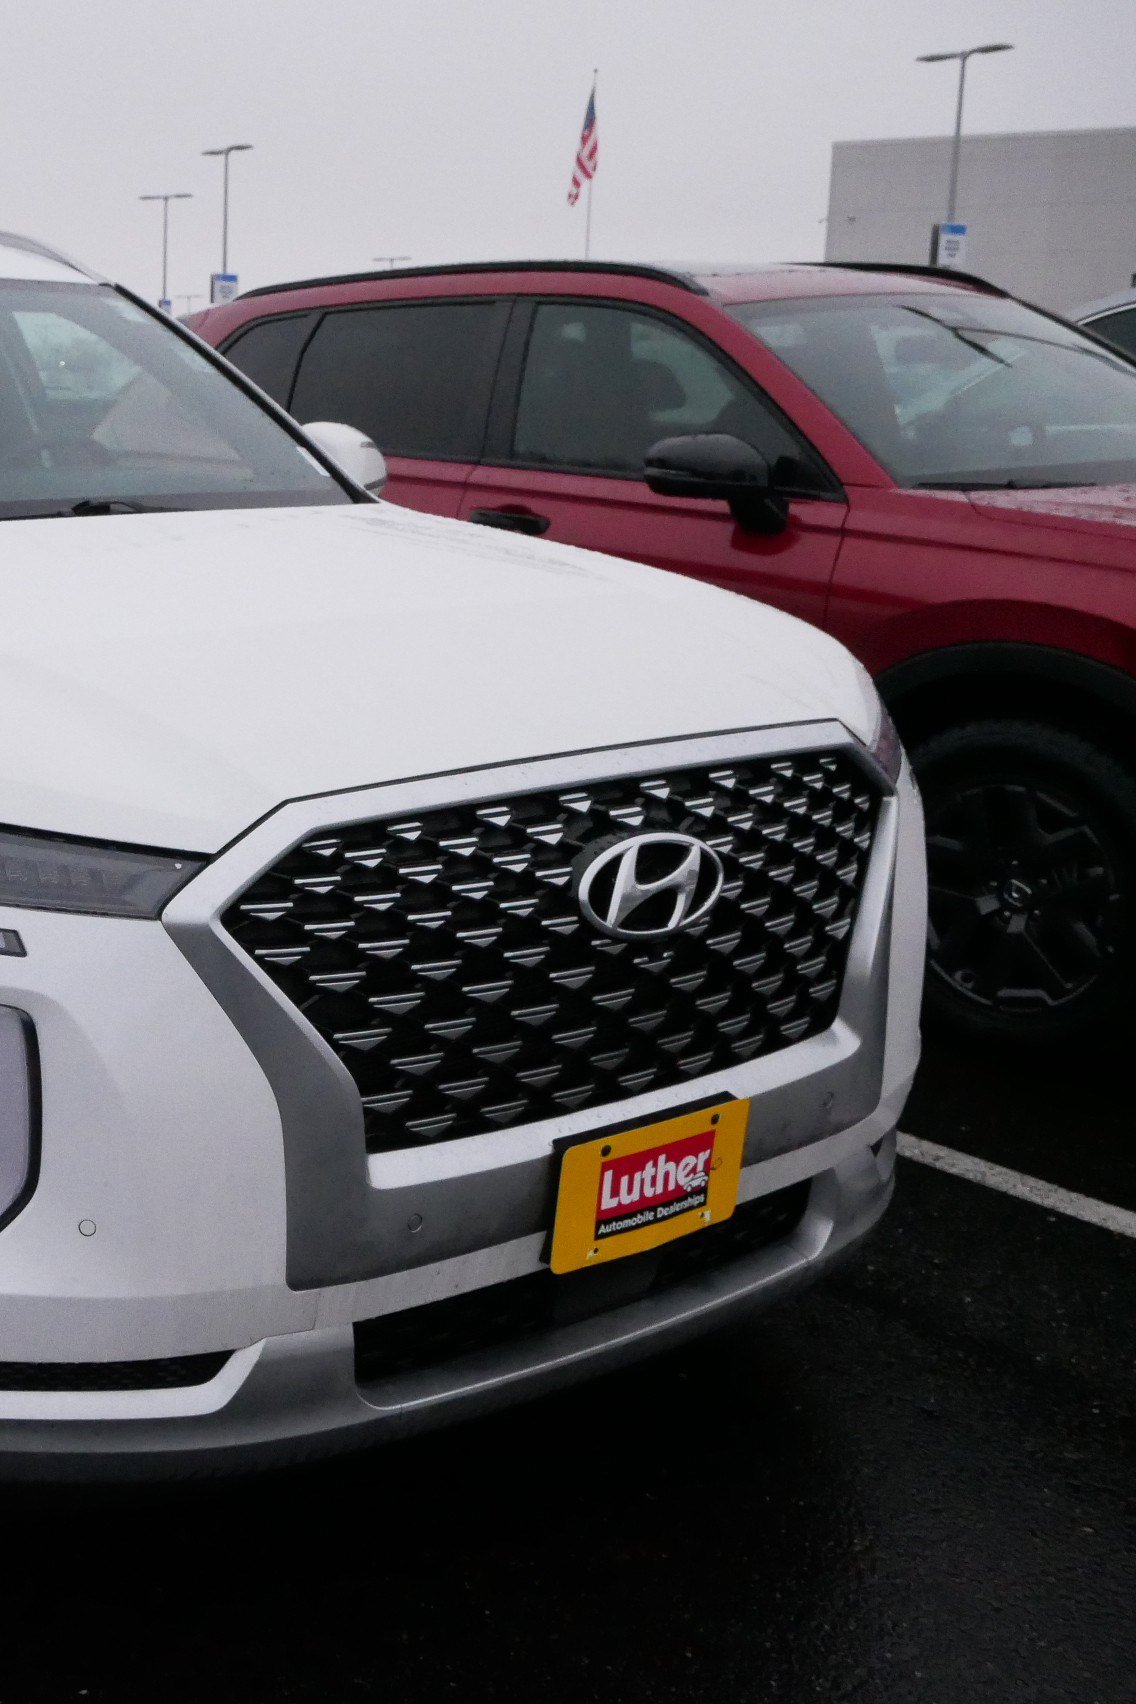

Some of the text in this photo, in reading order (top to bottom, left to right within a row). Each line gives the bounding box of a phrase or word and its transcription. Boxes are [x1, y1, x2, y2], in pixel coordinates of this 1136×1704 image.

[600, 1149, 711, 1210] Luther
[597, 1193, 705, 1235] Automobile Dealerships
